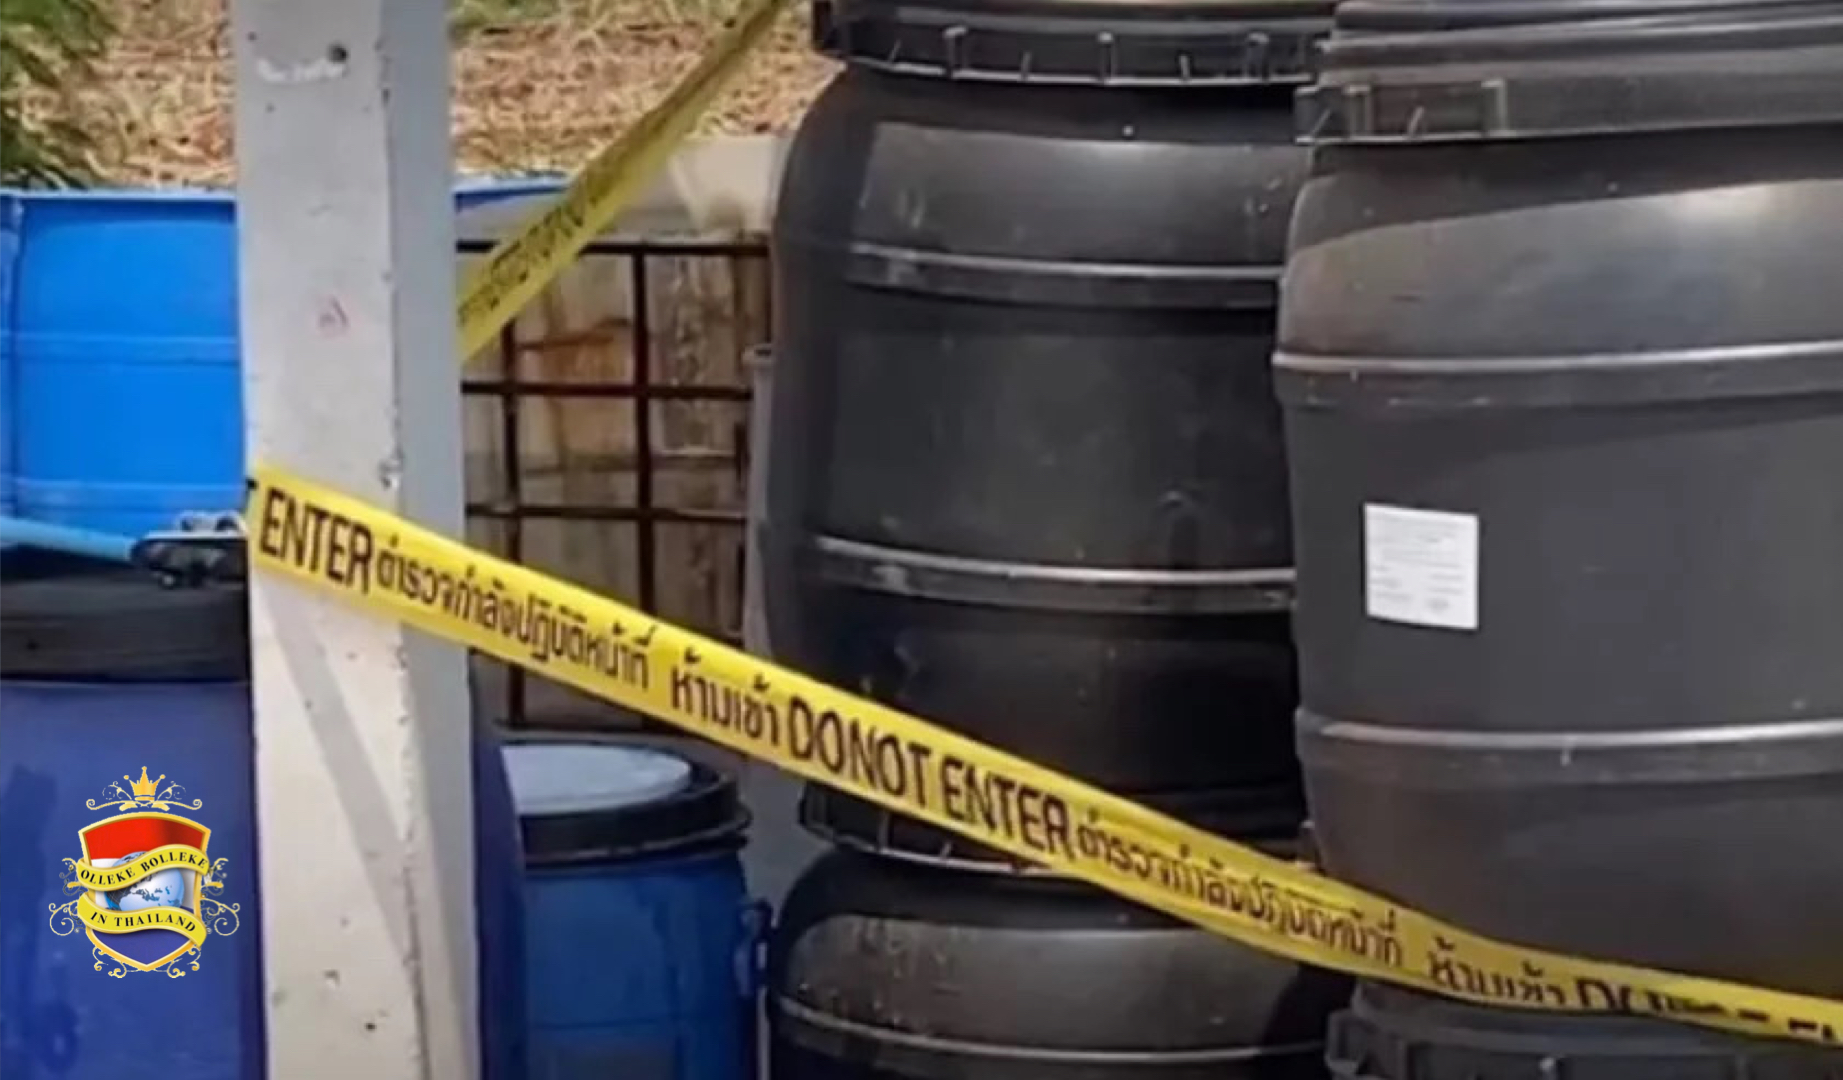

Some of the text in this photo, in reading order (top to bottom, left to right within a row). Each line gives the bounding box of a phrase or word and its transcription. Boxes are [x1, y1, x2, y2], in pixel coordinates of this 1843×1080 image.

[259, 487, 373, 594] ENTER
[672, 647, 780, 746] ห้ามเข้า
[941, 755, 1076, 861] ENTER
